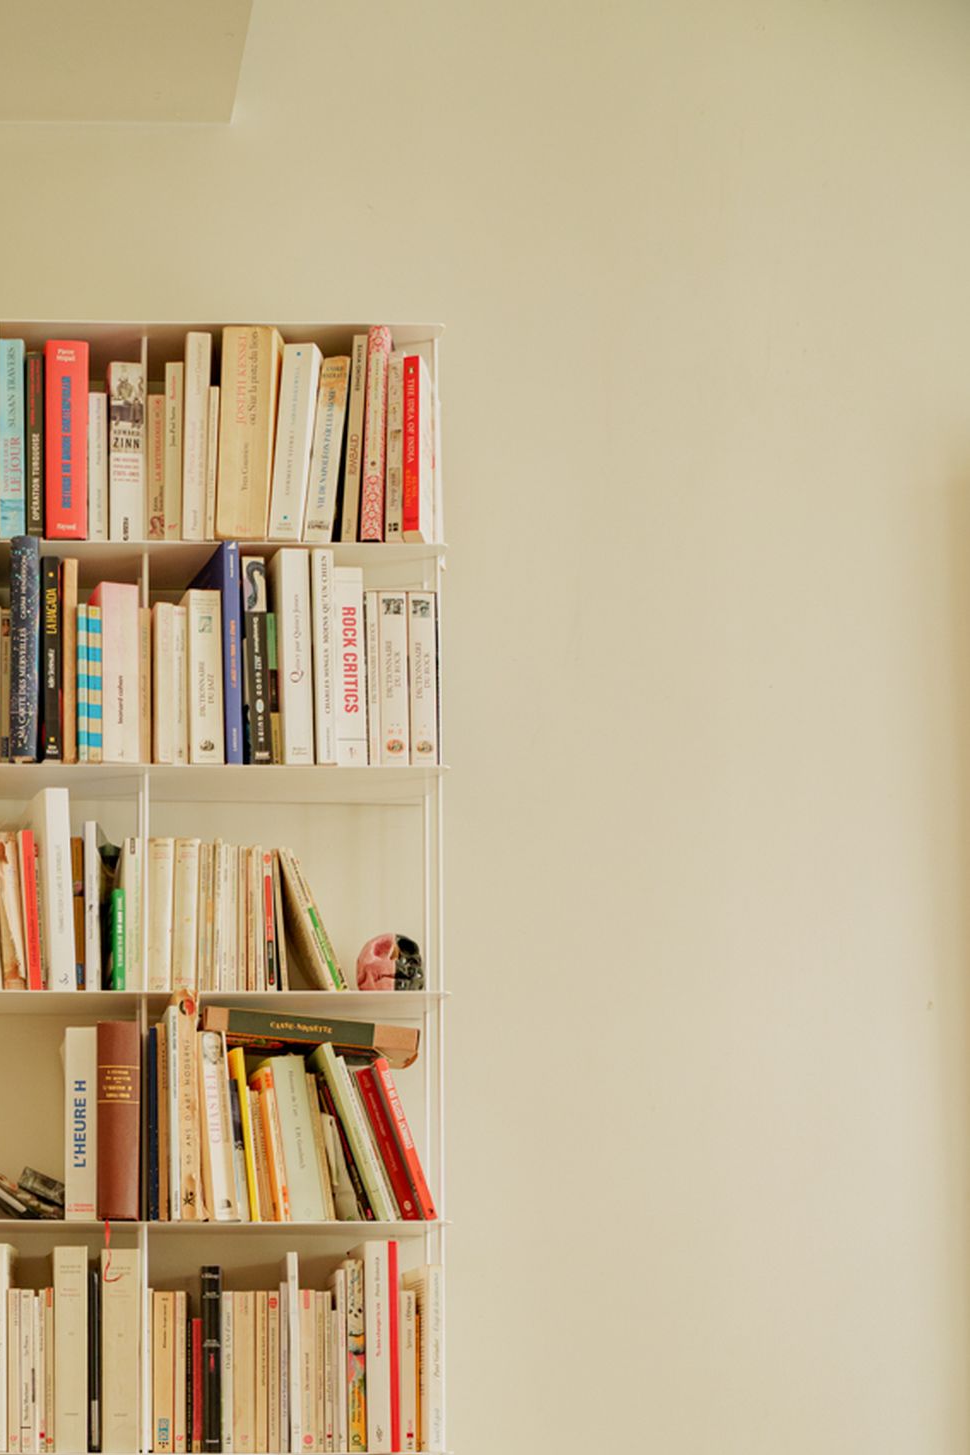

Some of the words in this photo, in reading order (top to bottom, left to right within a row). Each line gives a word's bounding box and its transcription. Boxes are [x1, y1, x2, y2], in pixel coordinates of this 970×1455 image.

[7, 347, 16, 394] TRAVERS
[237, 335, 247, 377] KESSEL
[236, 381, 247, 424] JOSEPH
[407, 378, 415, 396] THE
[8, 397, 16, 428] SUSAN
[407, 398, 415, 420] IDEA
[113, 437, 140, 449] ZINN
[323, 430, 332, 441] PAR
[407, 422, 415, 434] OF
[10, 437, 21, 474] JOUR
[31, 433, 40, 476] TURQUOISE
[319, 442, 330, 482] NAPOLÉON
[348, 434, 359, 476] RIMBAUD
[407, 436, 415, 463] INDIA
[10, 476, 20, 492] LE
[31, 478, 40, 520] OPÉRATION
[318, 483, 326, 495] DE
[317, 497, 325, 509] VIE
[46, 588, 57, 621] HAGADA
[46, 623, 56, 634] LA
[342, 607, 357, 647] ROCK
[18, 627, 27, 677] MERVEILLES
[393, 652, 401, 673] ROCK
[18, 678, 26, 693] DES
[343, 652, 359, 713] CRITICS
[385, 641, 393, 698] DICTIONNAIRE
[414, 642, 423, 699] DICTIONNAIRE
[424, 676, 431, 688] DU
[198, 660, 207, 717] DICTIONNAIRE
[18, 696, 26, 724] CARTE
[18, 724, 26, 738] MA
[74, 1080, 86, 1092] H
[205, 1070, 221, 1143] CHASTEL
[73, 1098, 87, 1168] L'HEURE
